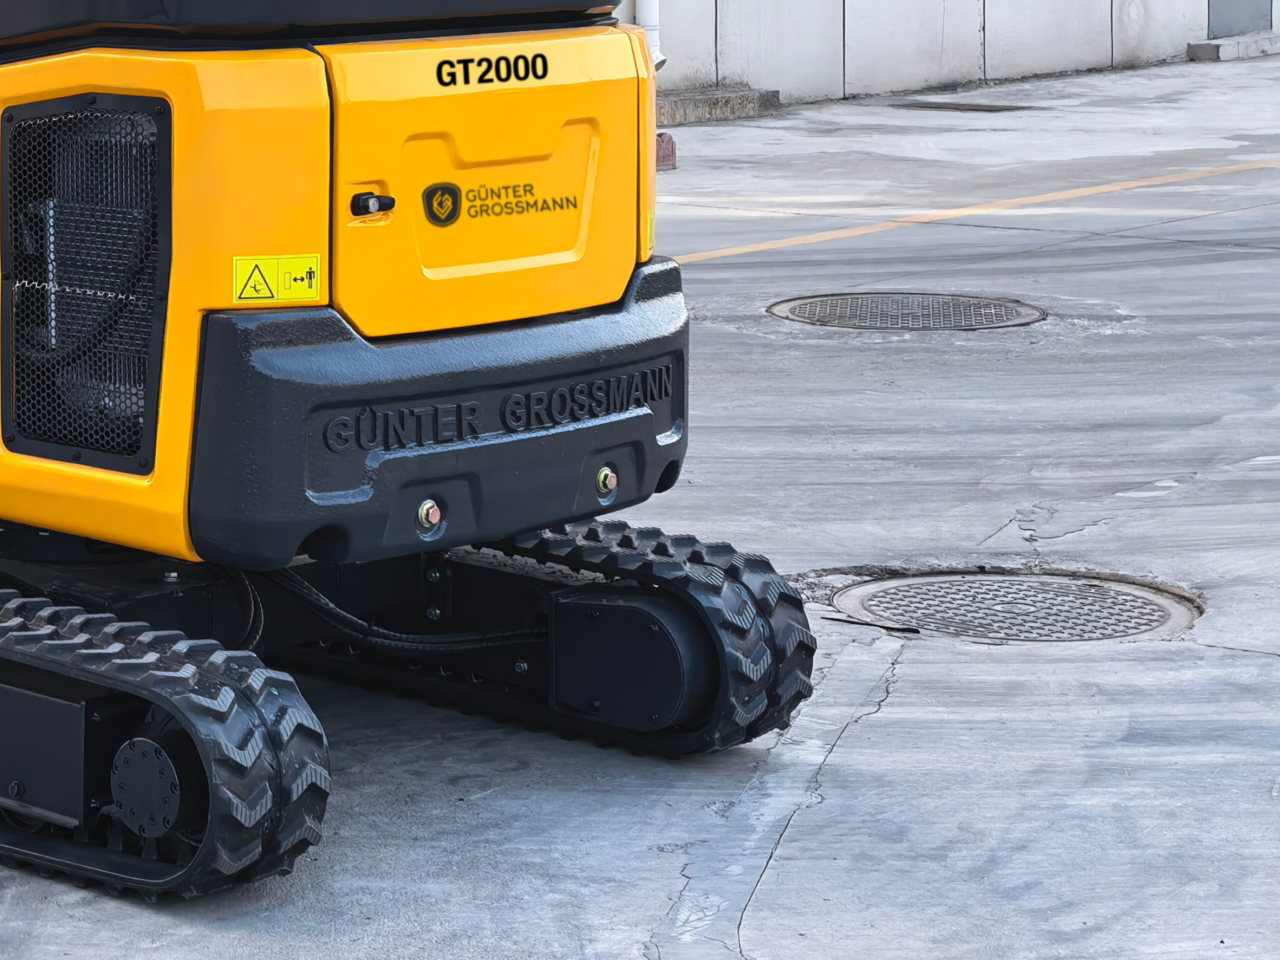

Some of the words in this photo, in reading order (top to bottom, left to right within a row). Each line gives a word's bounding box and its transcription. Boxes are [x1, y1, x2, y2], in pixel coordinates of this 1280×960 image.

[436, 53, 548, 87] GT2000
[465, 184, 535, 202] GÜNTER
[467, 196, 578, 218] GROSSMANN
[323, 403, 481, 452] GÜNTER
[500, 364, 672, 432] GROSSMANN
